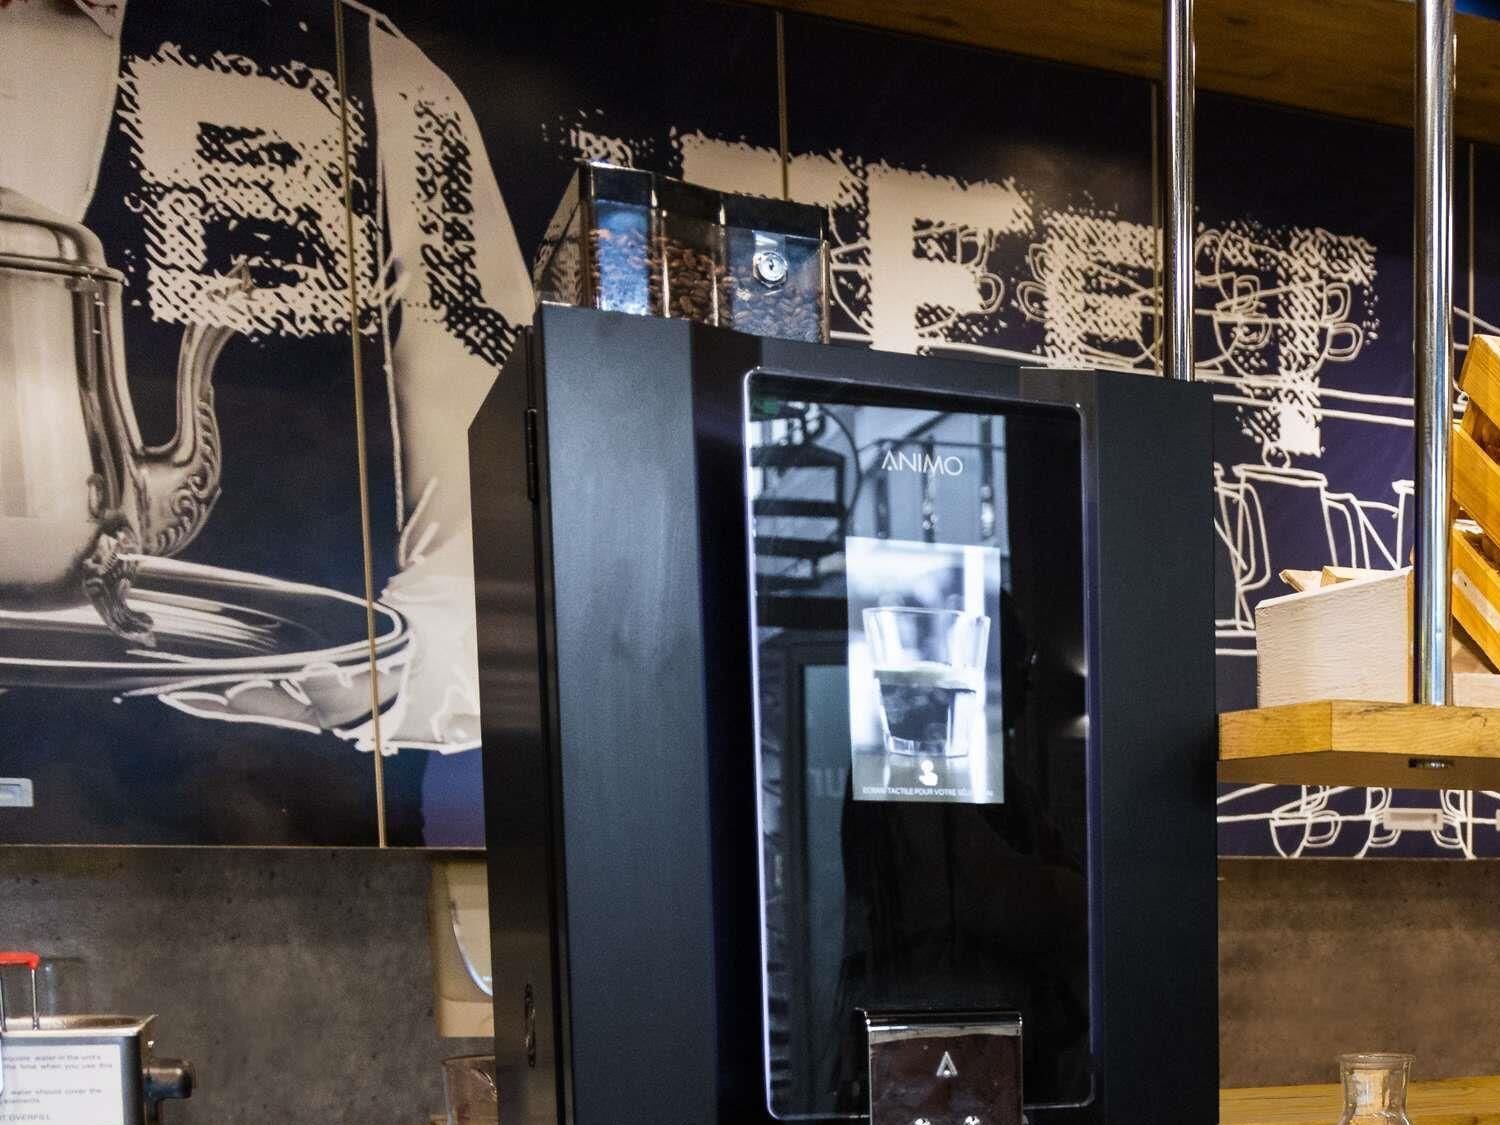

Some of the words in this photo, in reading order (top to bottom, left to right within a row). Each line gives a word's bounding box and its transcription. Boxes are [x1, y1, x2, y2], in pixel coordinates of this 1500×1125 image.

[881, 449, 964, 476] ANIMO
[887, 787, 914, 795] TACTILE
[914, 787, 934, 795] POUR
[934, 788, 957, 796] VOTRE
